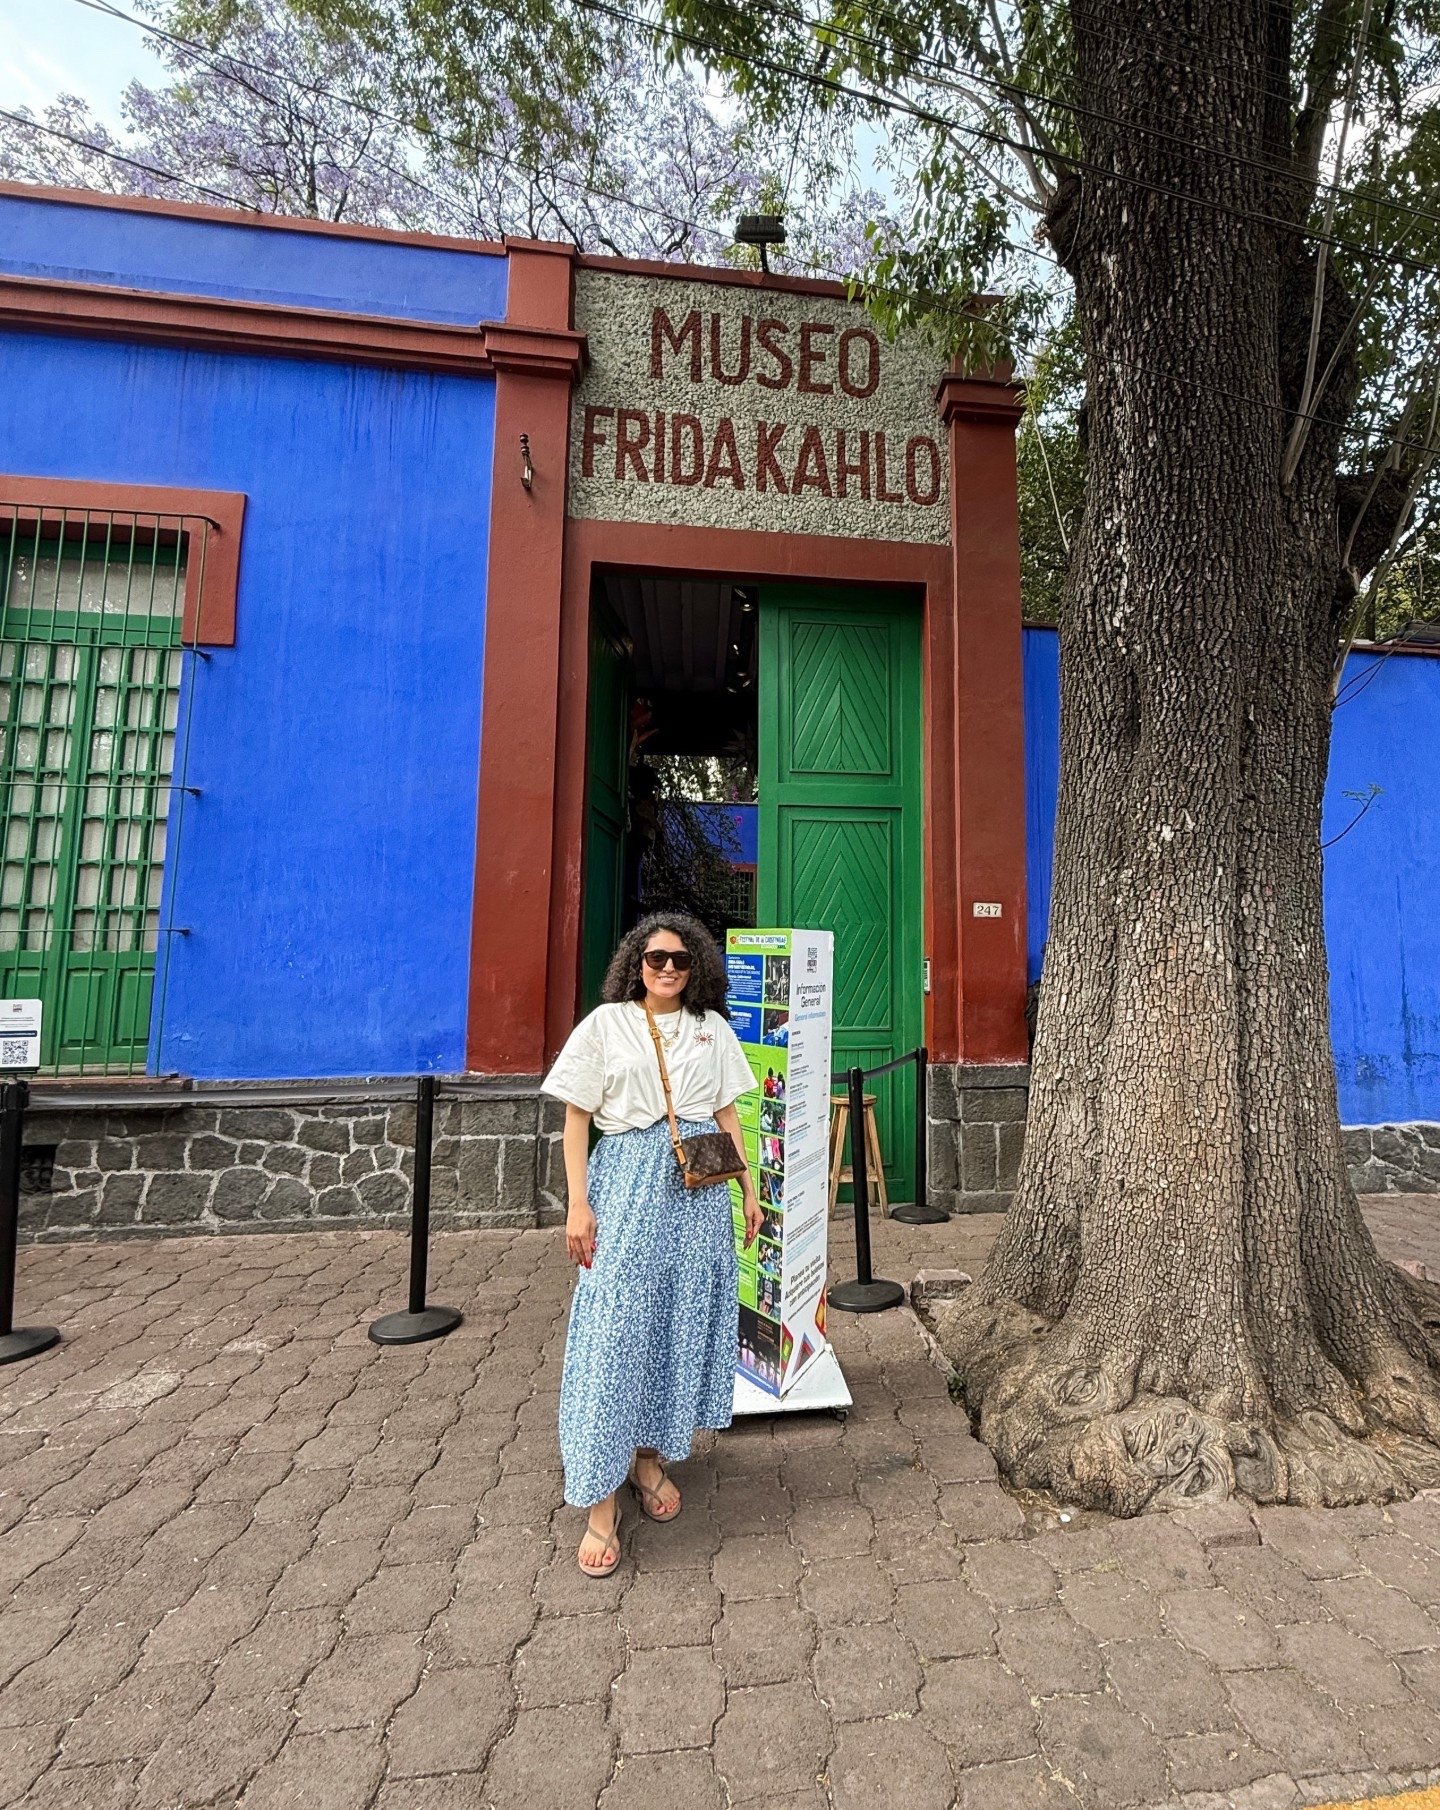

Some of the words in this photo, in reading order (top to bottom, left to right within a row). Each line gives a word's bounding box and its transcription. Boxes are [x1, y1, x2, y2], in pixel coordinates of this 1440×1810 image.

[650, 306, 881, 399] MUSEO
[581, 404, 745, 491] FRIDA
[756, 420, 941, 506] KAHLO
[977, 905, 999, 915] 247
[796, 982, 826, 995] Información
[801, 995, 821, 1008] General
